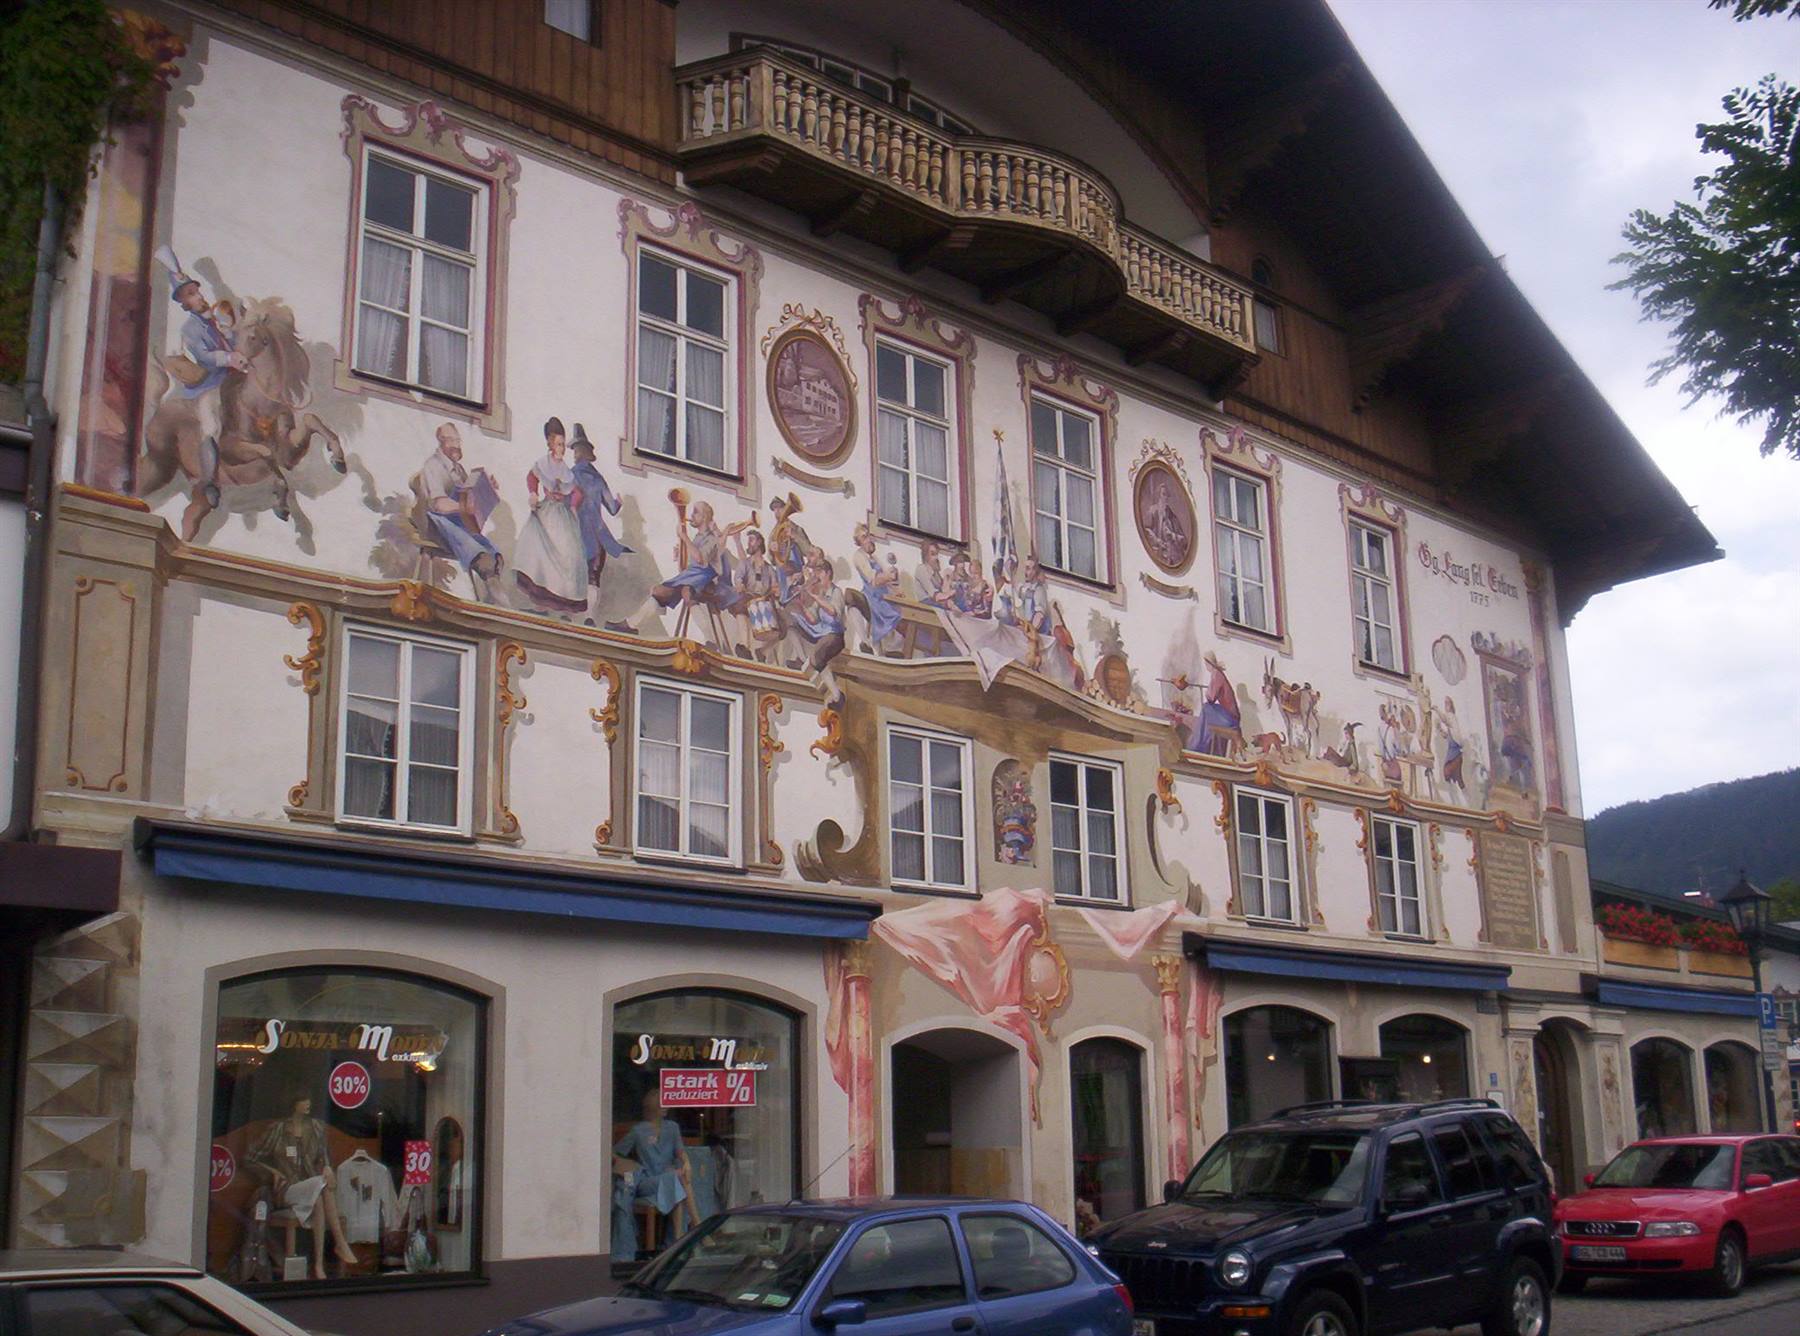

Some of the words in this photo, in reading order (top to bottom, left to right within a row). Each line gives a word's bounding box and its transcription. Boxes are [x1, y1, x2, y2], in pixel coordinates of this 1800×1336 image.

[1760, 997, 1771, 1025] P
[333, 1076, 366, 1094] 30%
[664, 1072, 718, 1088] stark
[663, 1088, 719, 1100] reduziert
[406, 1152, 431, 1172] 30
